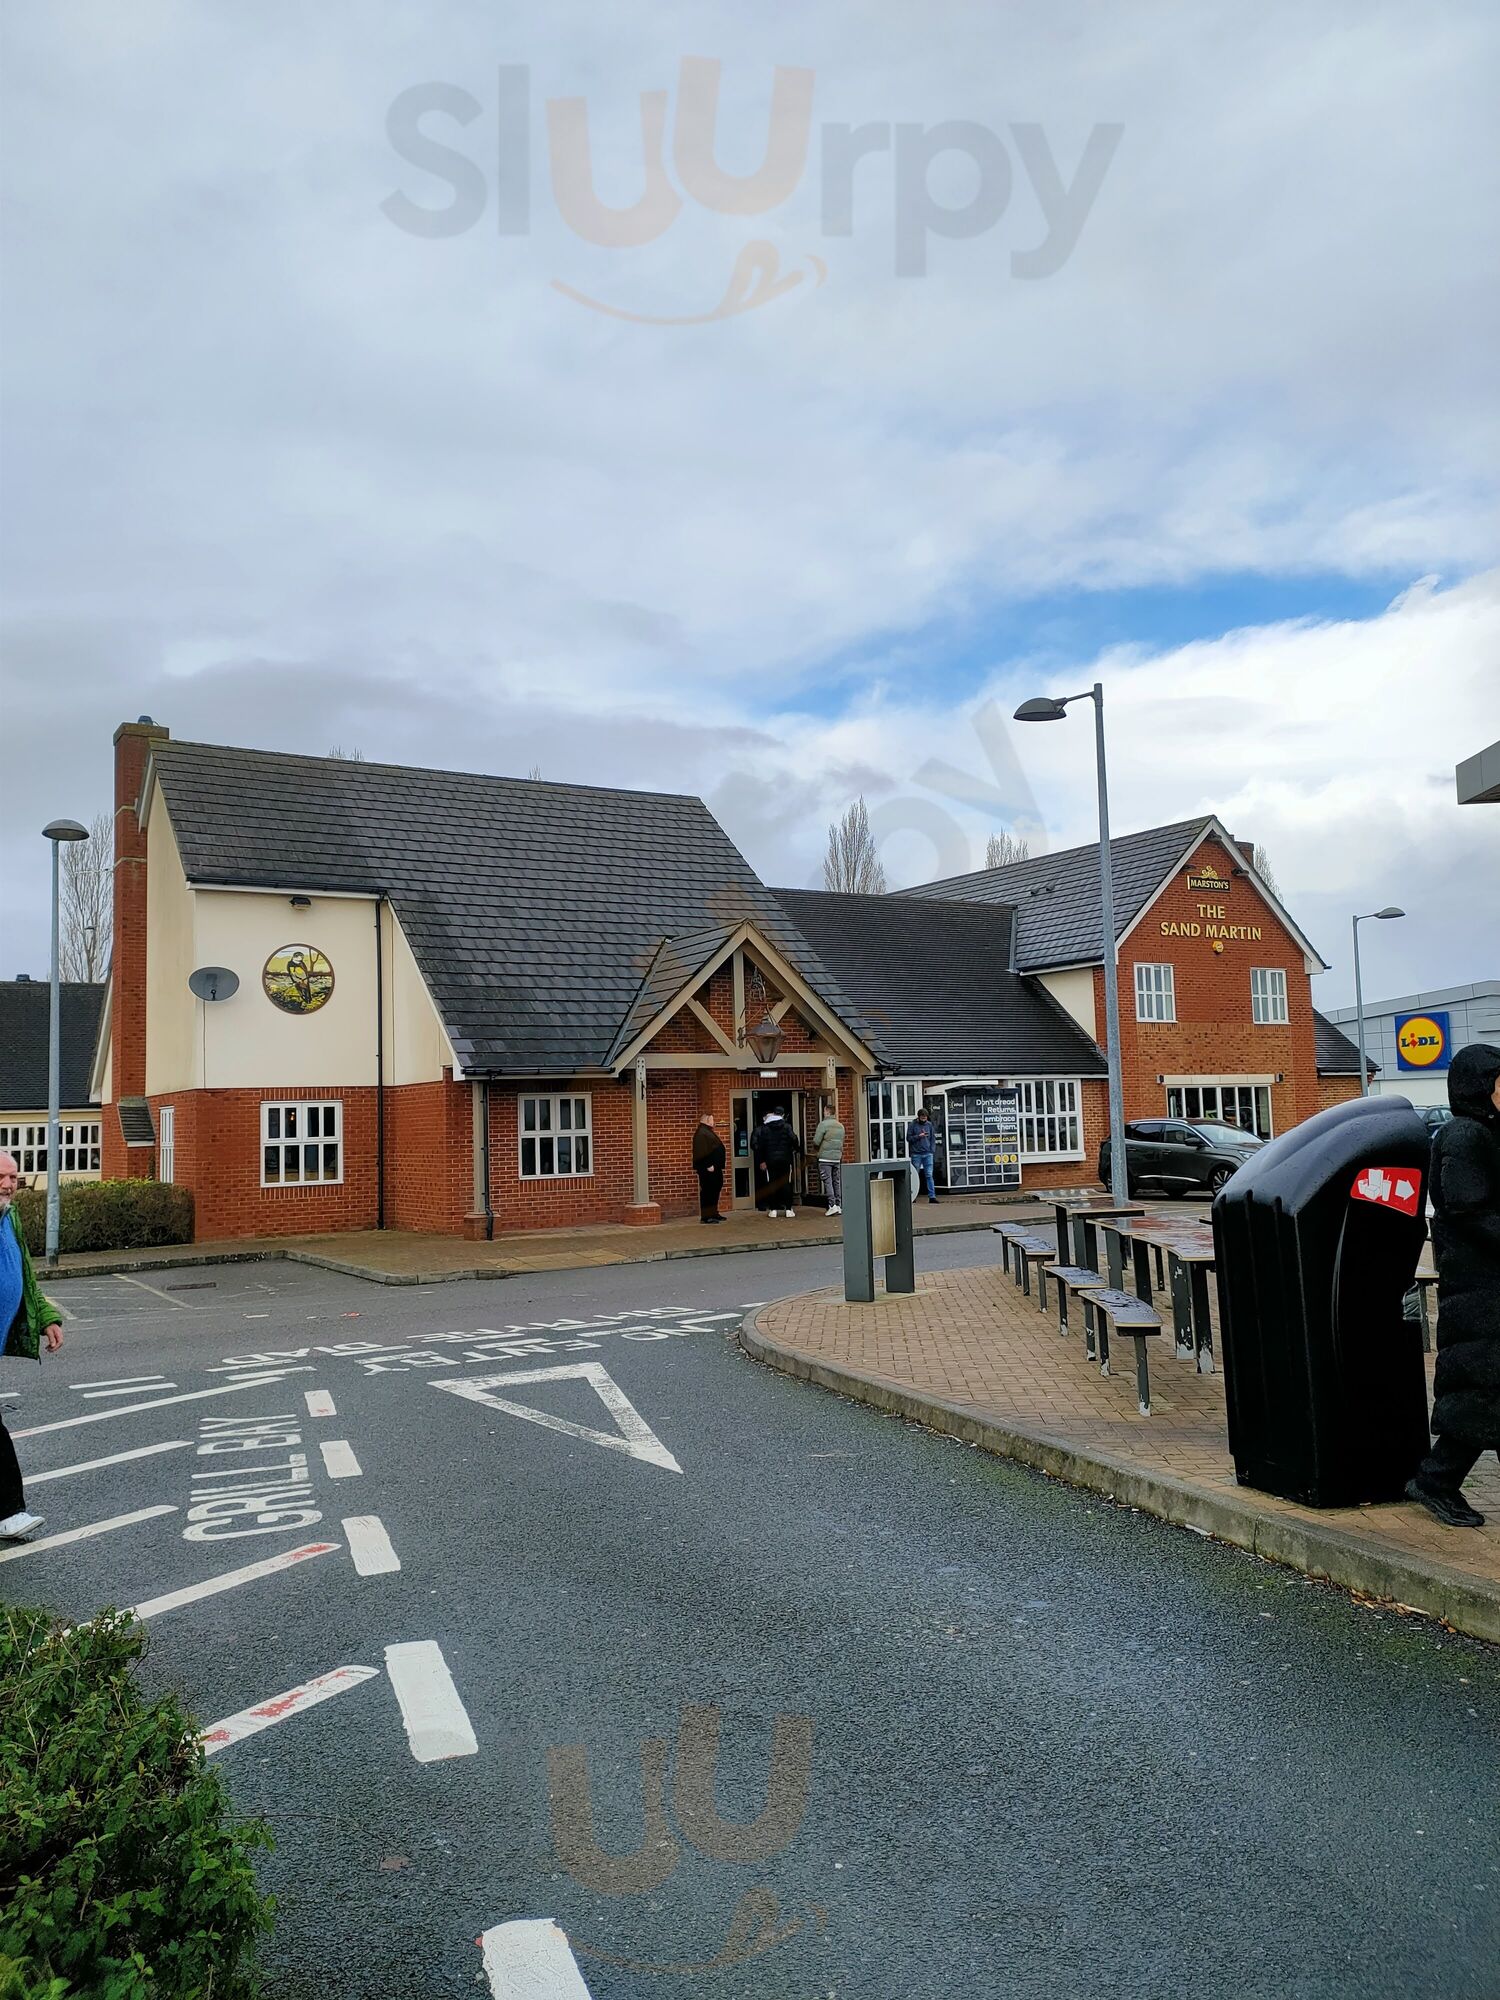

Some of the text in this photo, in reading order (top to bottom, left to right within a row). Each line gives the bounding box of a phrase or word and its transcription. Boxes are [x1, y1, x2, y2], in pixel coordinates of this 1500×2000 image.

[1190, 880, 1229, 890] MARSTON'S
[1196, 904, 1226, 919] THE
[1160, 922, 1262, 940] SAND MARTIN
[995, 1097, 1016, 1106] dread
[363, 1324, 716, 1376] NO ENTRY
[182, 1413, 323, 1541] GRILL BAY
